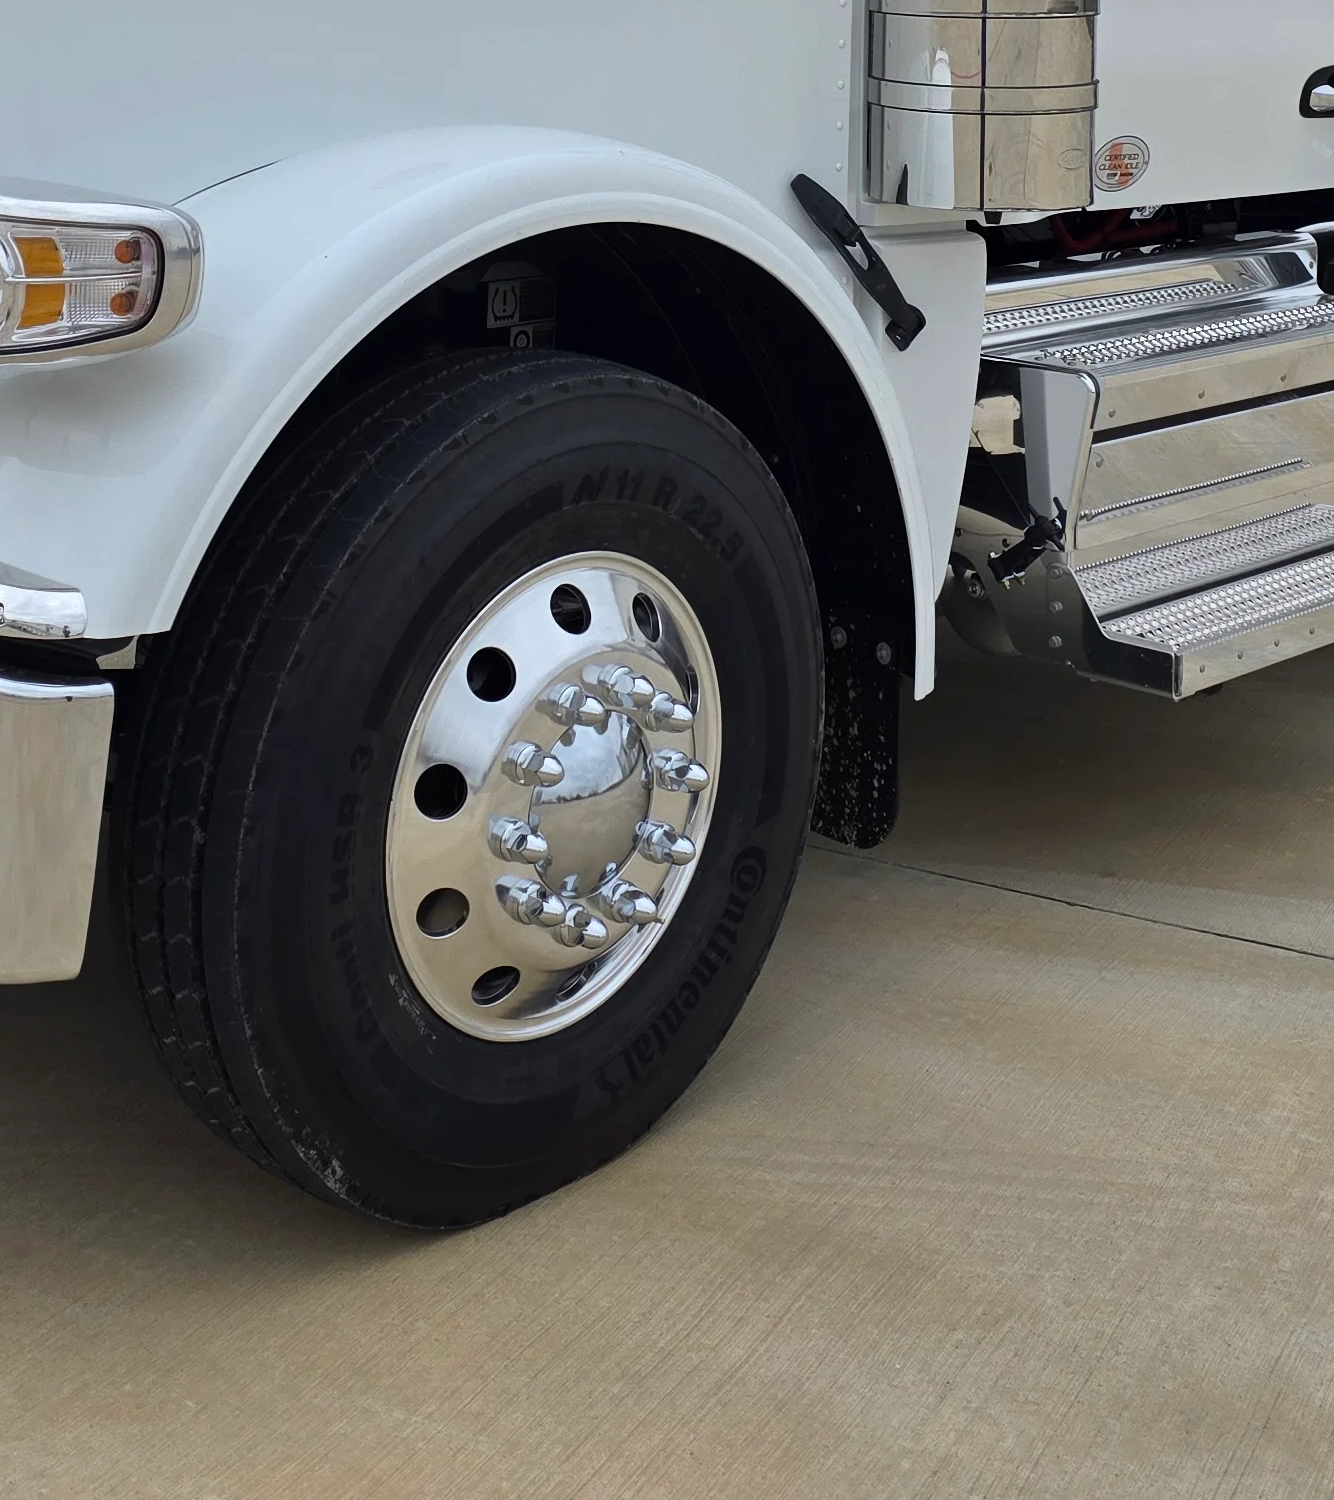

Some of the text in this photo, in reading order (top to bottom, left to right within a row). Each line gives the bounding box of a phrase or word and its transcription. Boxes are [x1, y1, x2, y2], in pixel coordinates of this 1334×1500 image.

[1104, 153, 1140, 162] CERTIFIED
[1098, 161, 1141, 171] CLEAN IDLE
[620, 845, 767, 1084] Continental
